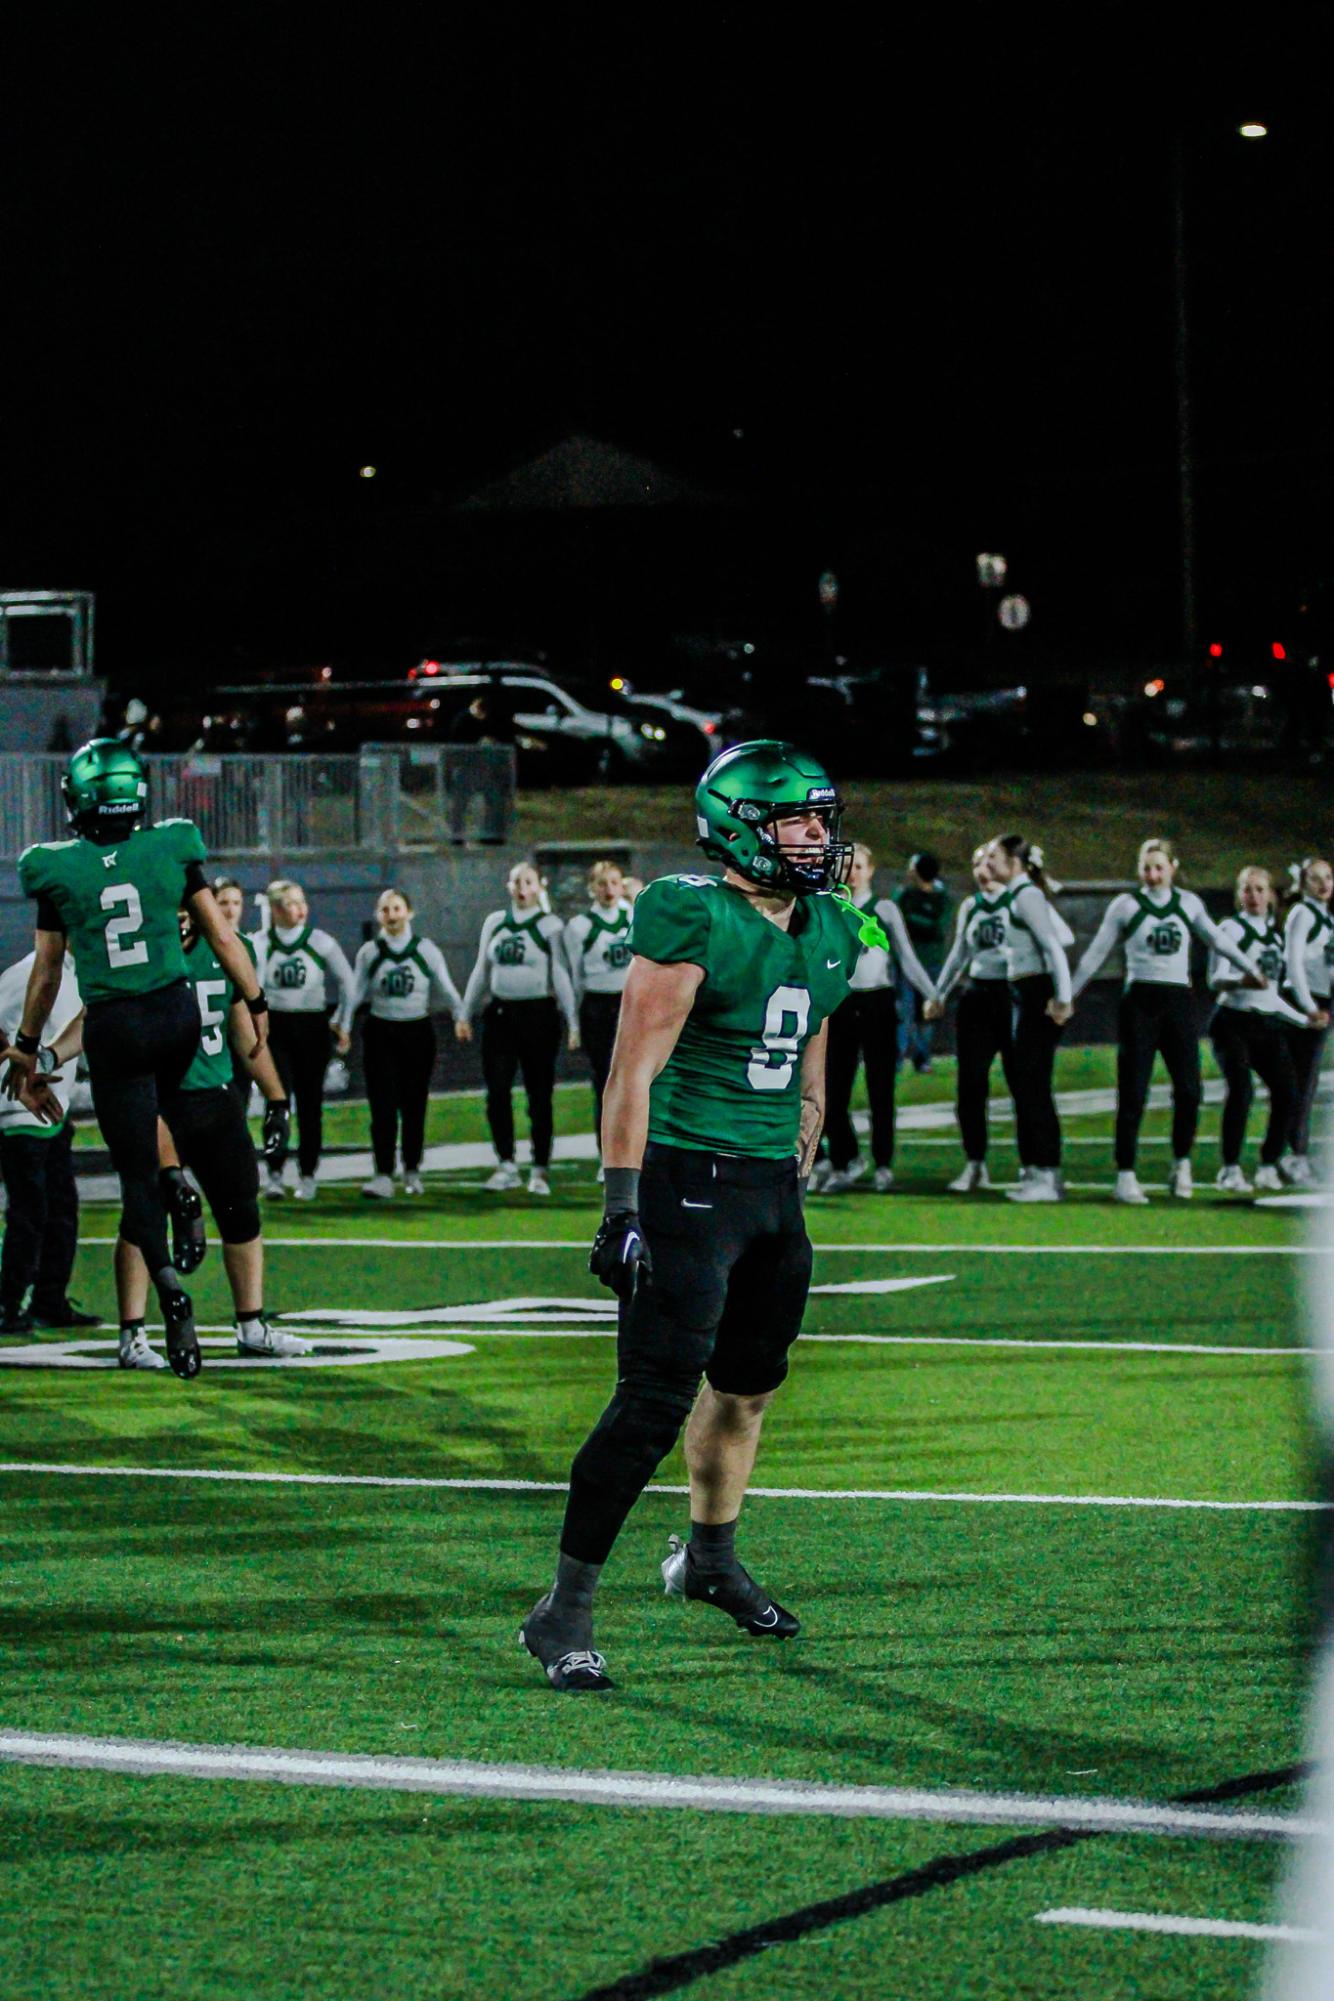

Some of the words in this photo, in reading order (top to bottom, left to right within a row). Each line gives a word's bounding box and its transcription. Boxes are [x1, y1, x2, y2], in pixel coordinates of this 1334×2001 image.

[97, 803, 140, 815] Riddell
[99, 883, 149, 969] 2
[196, 980, 226, 1056] 5
